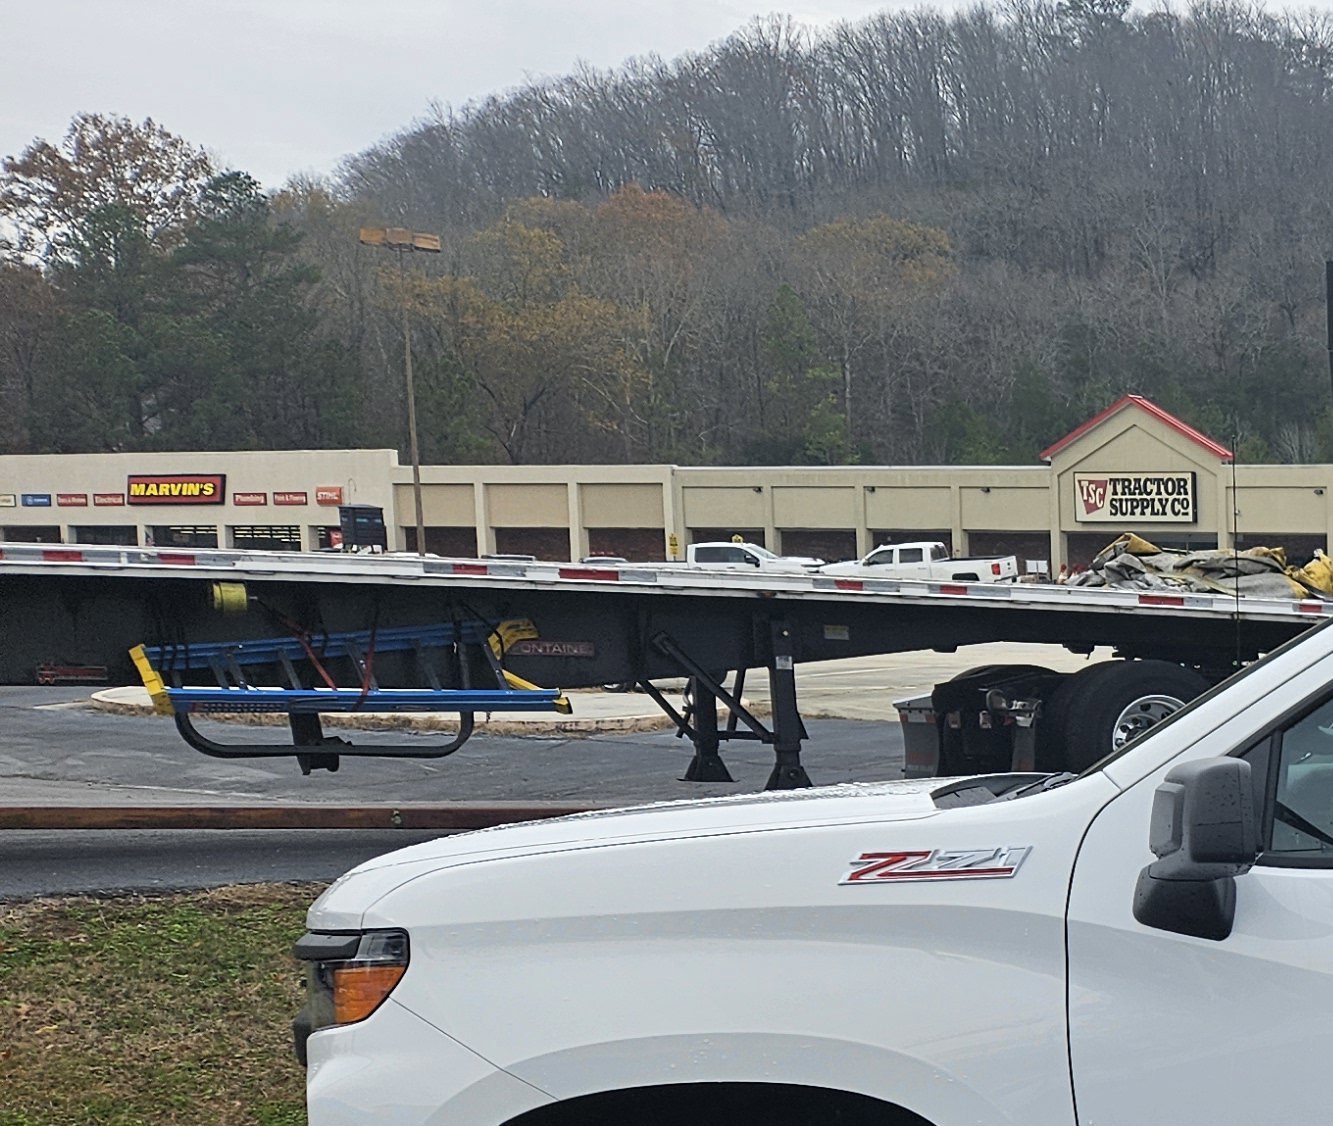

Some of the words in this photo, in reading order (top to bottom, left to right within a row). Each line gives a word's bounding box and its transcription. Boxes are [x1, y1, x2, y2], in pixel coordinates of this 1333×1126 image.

[130, 482, 215, 496] MARVIN'S
[1080, 480, 1104, 508] TSC
[1109, 477, 1189, 496] TRACTOR
[1110, 498, 1169, 516] SUPPLY
[838, 846, 1034, 886] Z71
